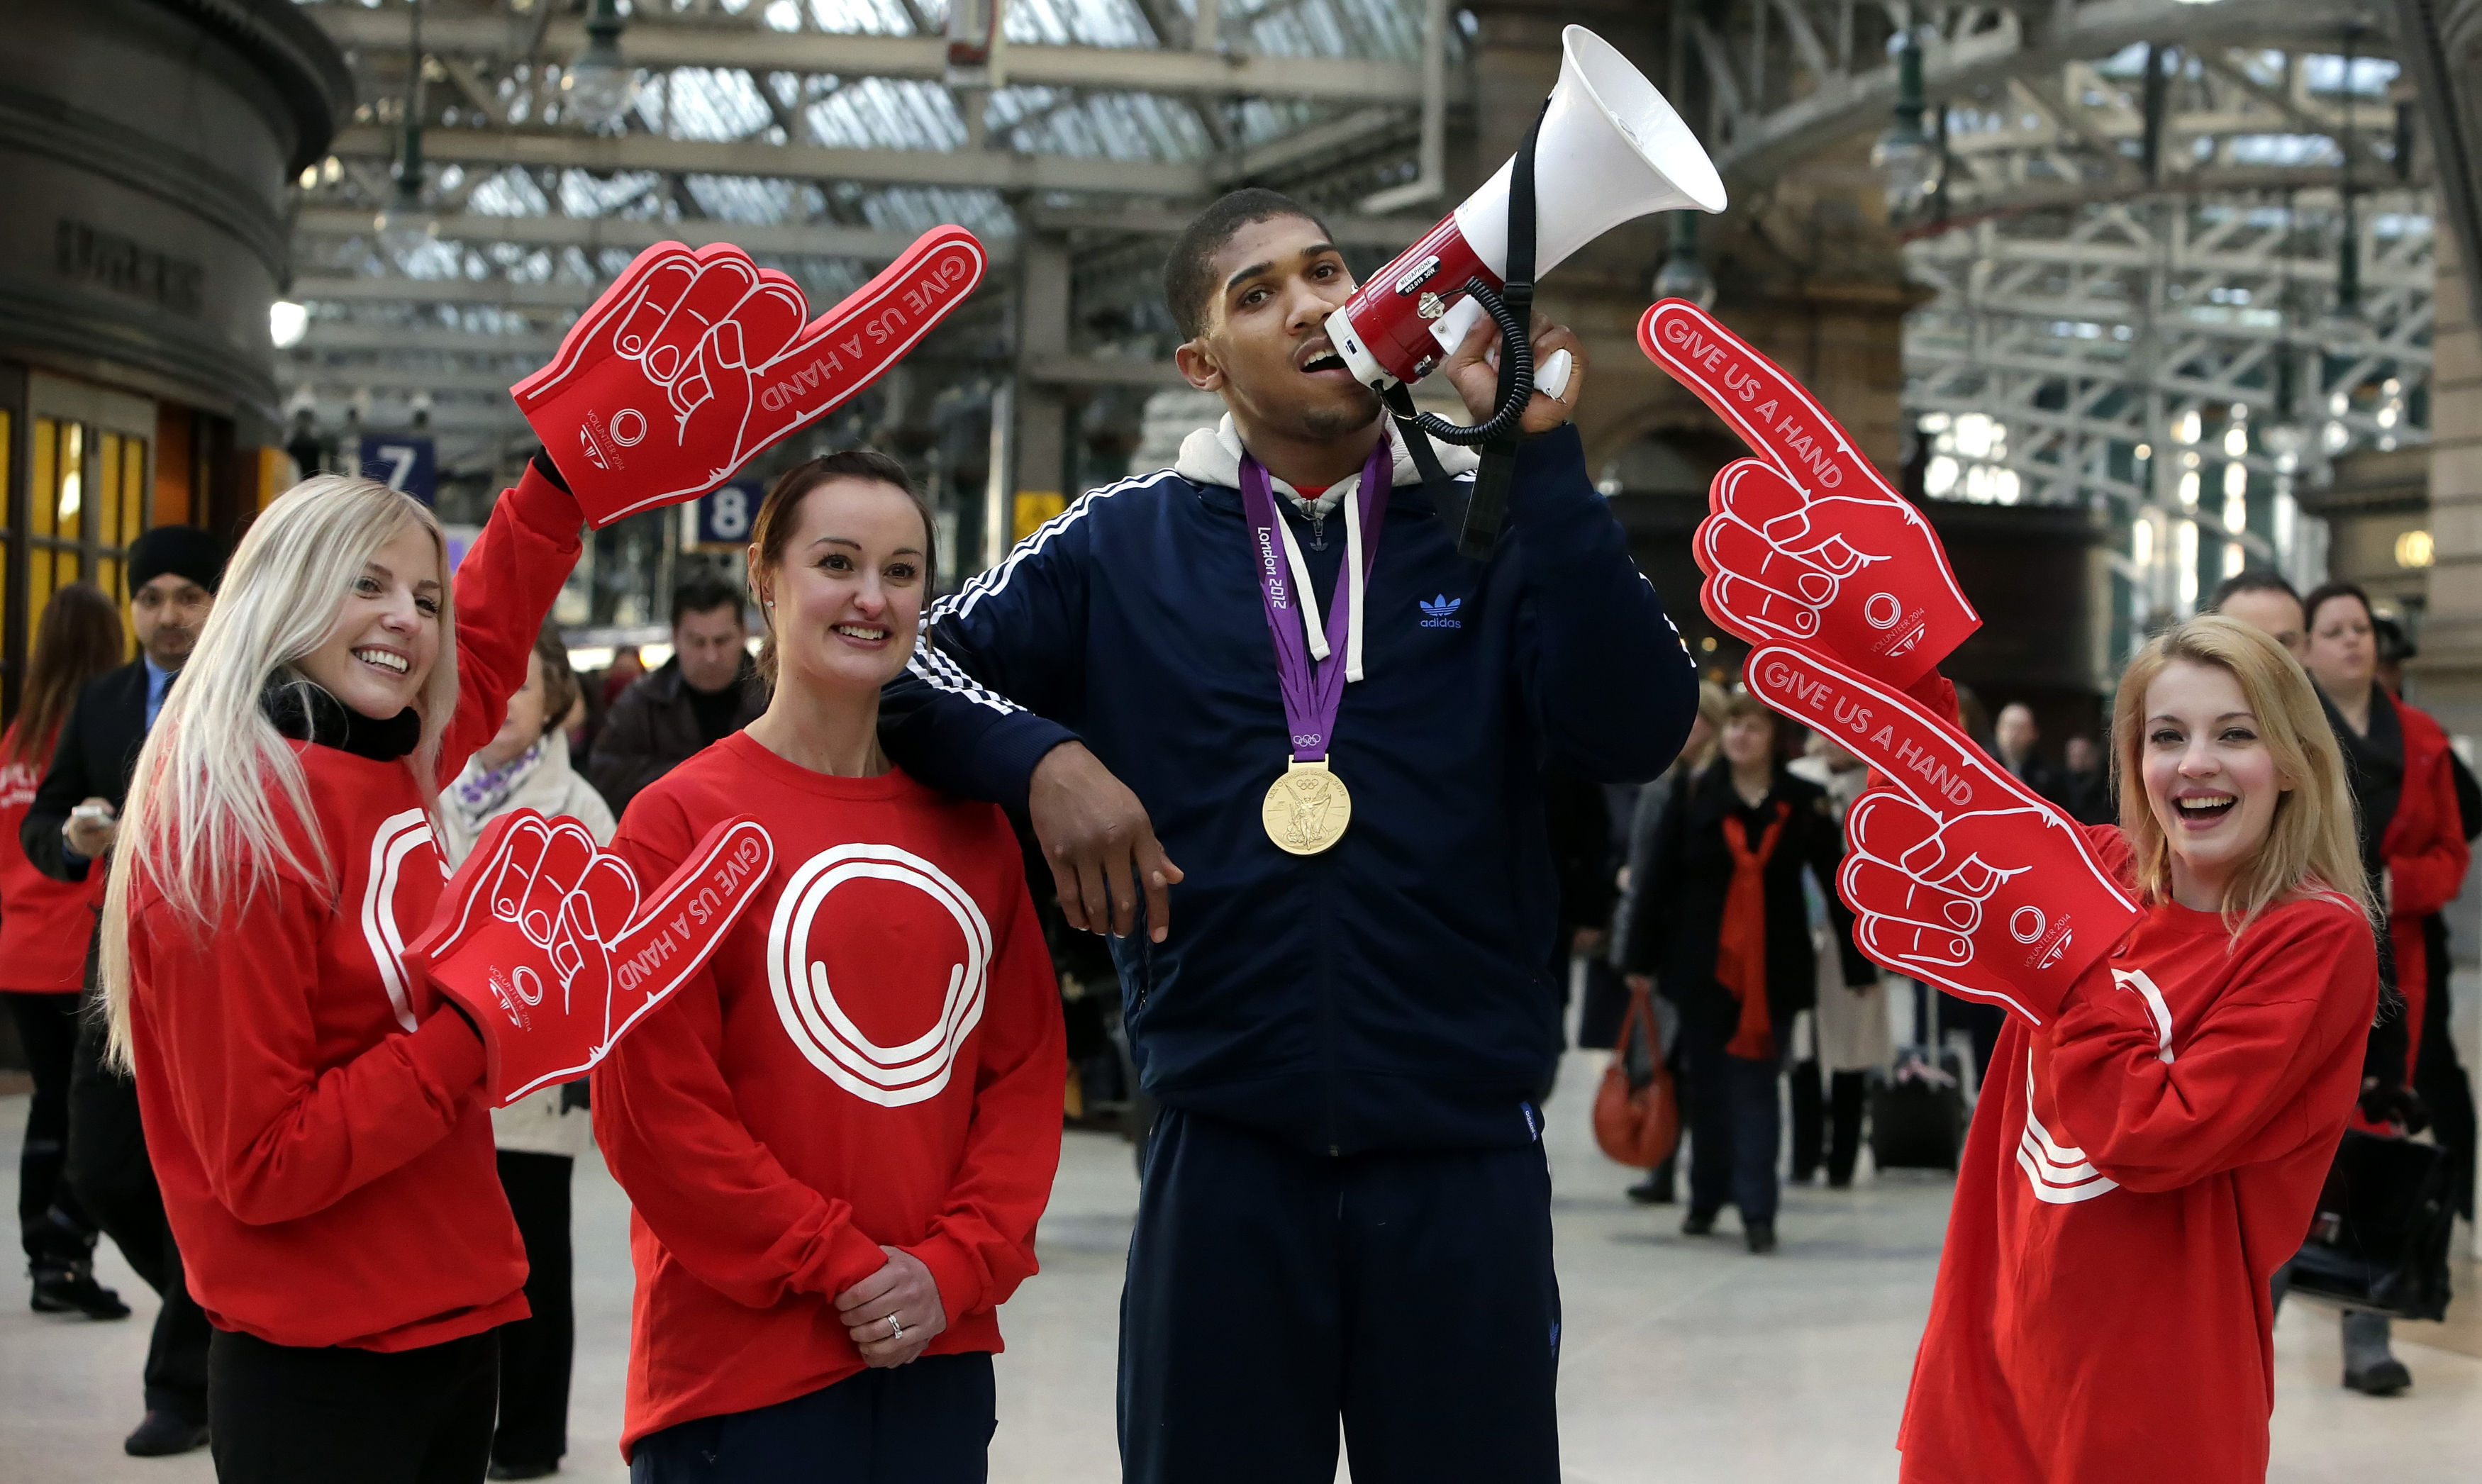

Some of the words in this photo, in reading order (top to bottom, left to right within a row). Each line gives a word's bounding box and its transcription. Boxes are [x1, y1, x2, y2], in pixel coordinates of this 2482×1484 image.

[902, 256, 966, 316] GIVE
[1400, 260, 1432, 286] MEGAPHONE
[1424, 267, 1435, 279] 30W
[840, 333, 863, 359] A
[866, 308, 908, 345] US
[761, 350, 844, 411] HAND
[1664, 318, 1727, 374] GIVE
[1724, 363, 1762, 402] US
[1754, 399, 1779, 425] A
[1774, 415, 1843, 489] HAND
[587, 409, 616, 454] VOLUNTEER
[612, 454, 625, 471] 2014
[377, 445, 416, 492] 7
[711, 487, 747, 539] 8
[1257, 527, 1278, 575] London
[1269, 579, 1287, 609] 2012
[1420, 618, 1462, 629] adidas
[1870, 618, 1910, 652] VOLUNTEER
[1908, 608, 1925, 622] 2014
[1764, 662, 1833, 711] GIVE
[1833, 696, 1874, 733] US
[1870, 725, 1893, 752] A
[1895, 737, 1974, 805] HAND
[713, 837, 761, 897] GIVE
[669, 912, 691, 939] A
[688, 887, 722, 925] US
[617, 930, 677, 991] HAND
[2023, 928, 2056, 968] VOLUNTEER
[2054, 913, 2071, 931] 2014
[489, 965, 525, 1010] VOLUNTEER
